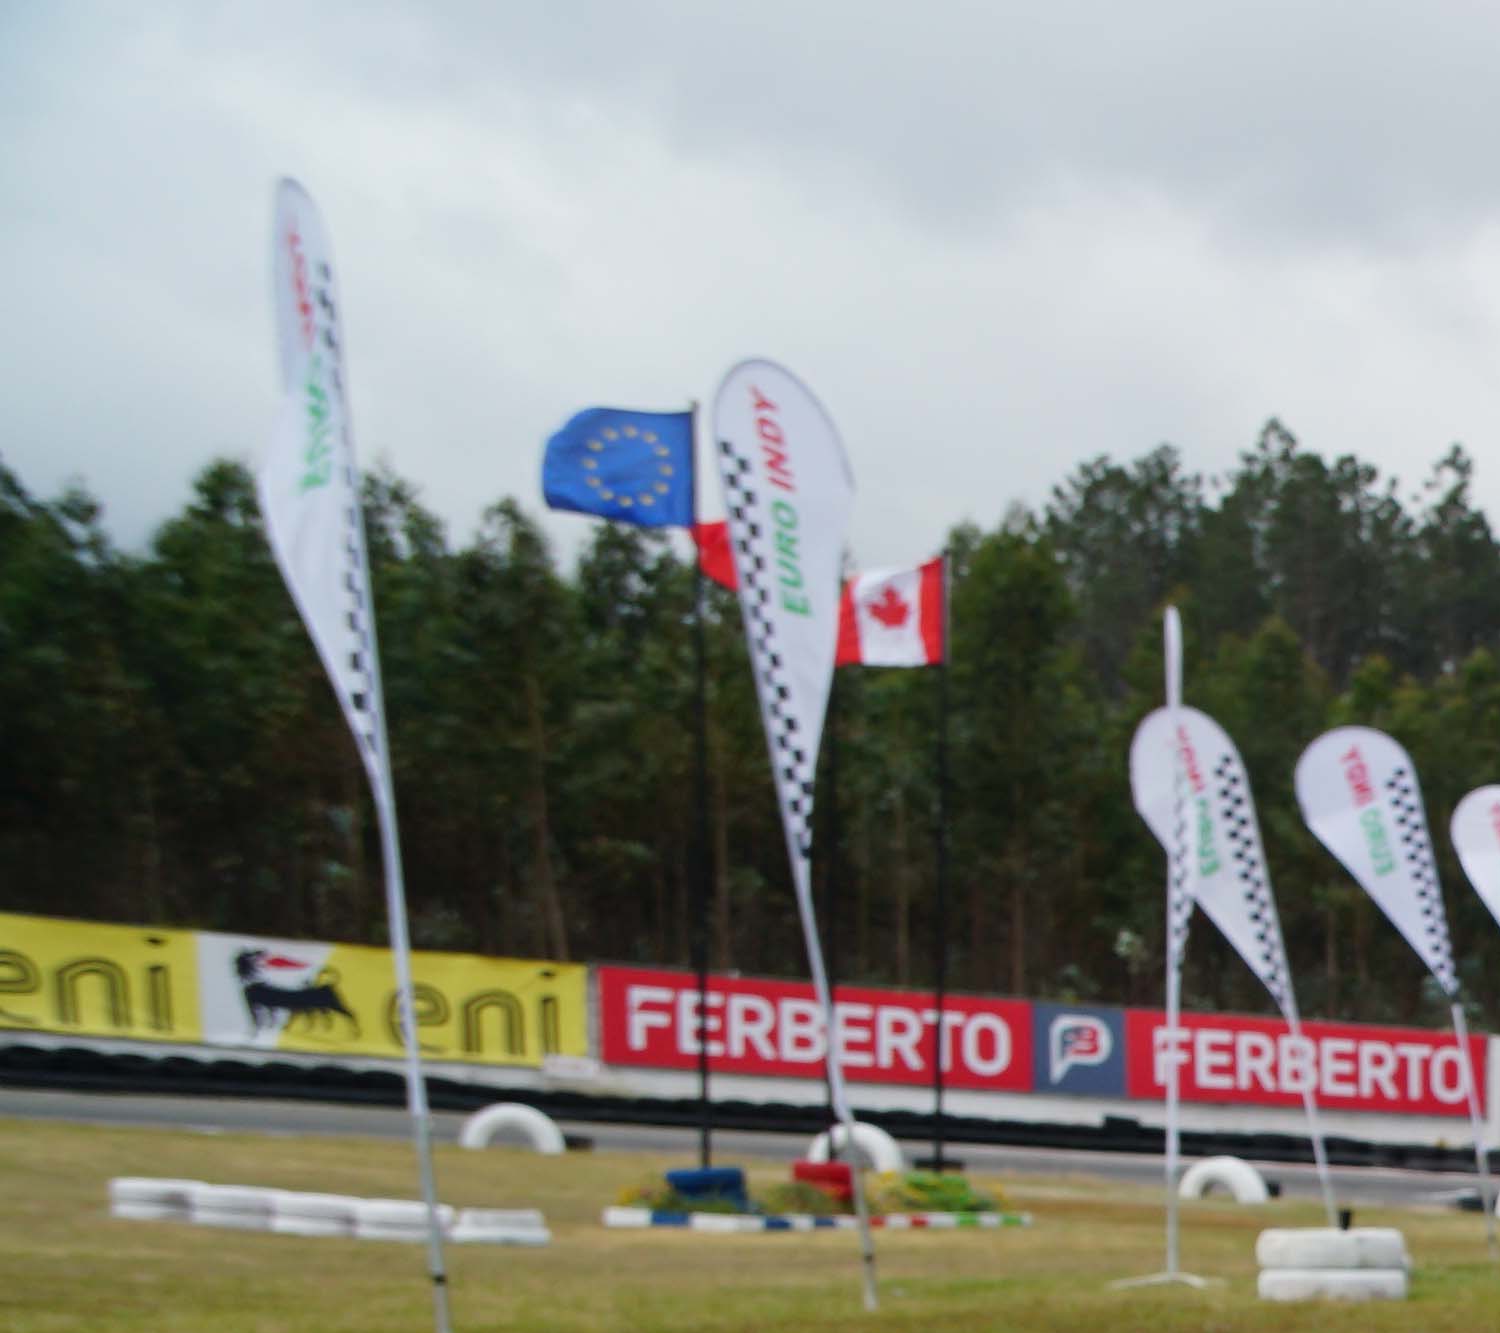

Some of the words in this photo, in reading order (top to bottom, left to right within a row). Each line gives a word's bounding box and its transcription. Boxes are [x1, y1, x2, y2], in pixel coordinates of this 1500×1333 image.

[383, 968, 562, 1056] eni
[626, 984, 1013, 1077] FERBERTO
[1152, 1026, 1473, 1104] FERBERTO
